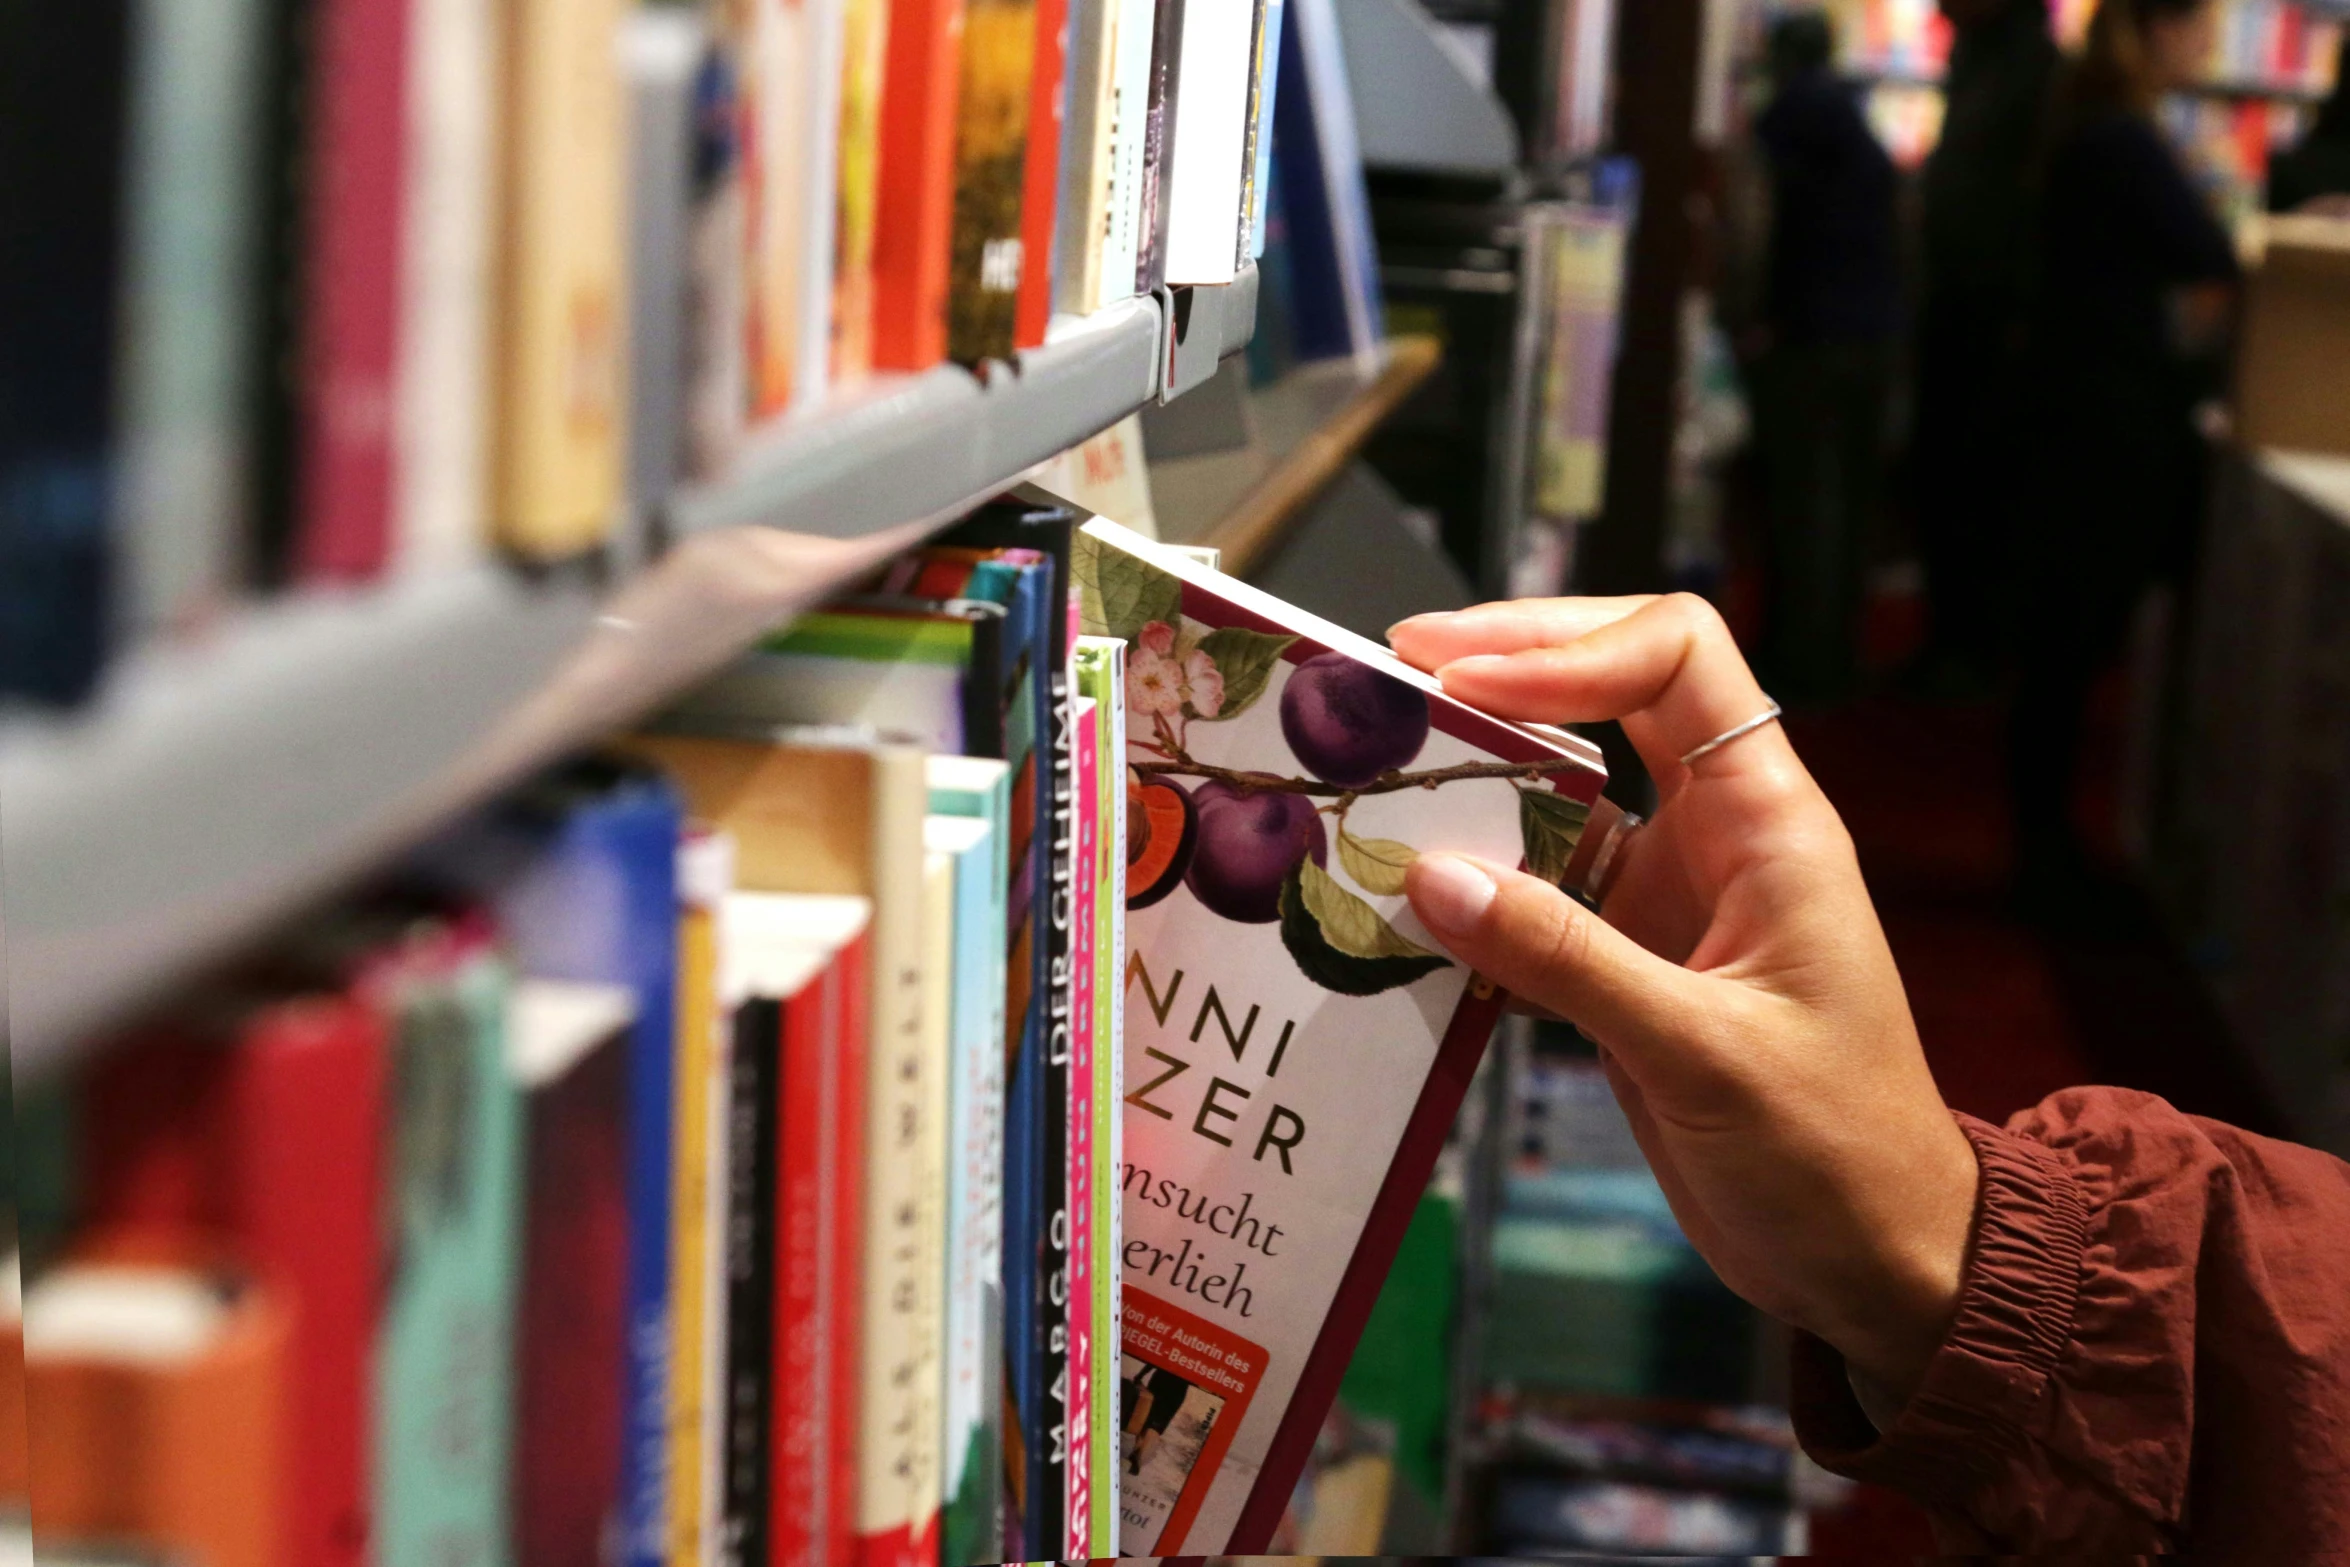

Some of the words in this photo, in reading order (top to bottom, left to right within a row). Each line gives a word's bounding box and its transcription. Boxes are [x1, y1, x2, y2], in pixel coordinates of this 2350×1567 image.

[1147, 1316, 1171, 1336] der
[1172, 1328, 1222, 1361] Autorin
[1224, 1353, 1250, 1374] des
